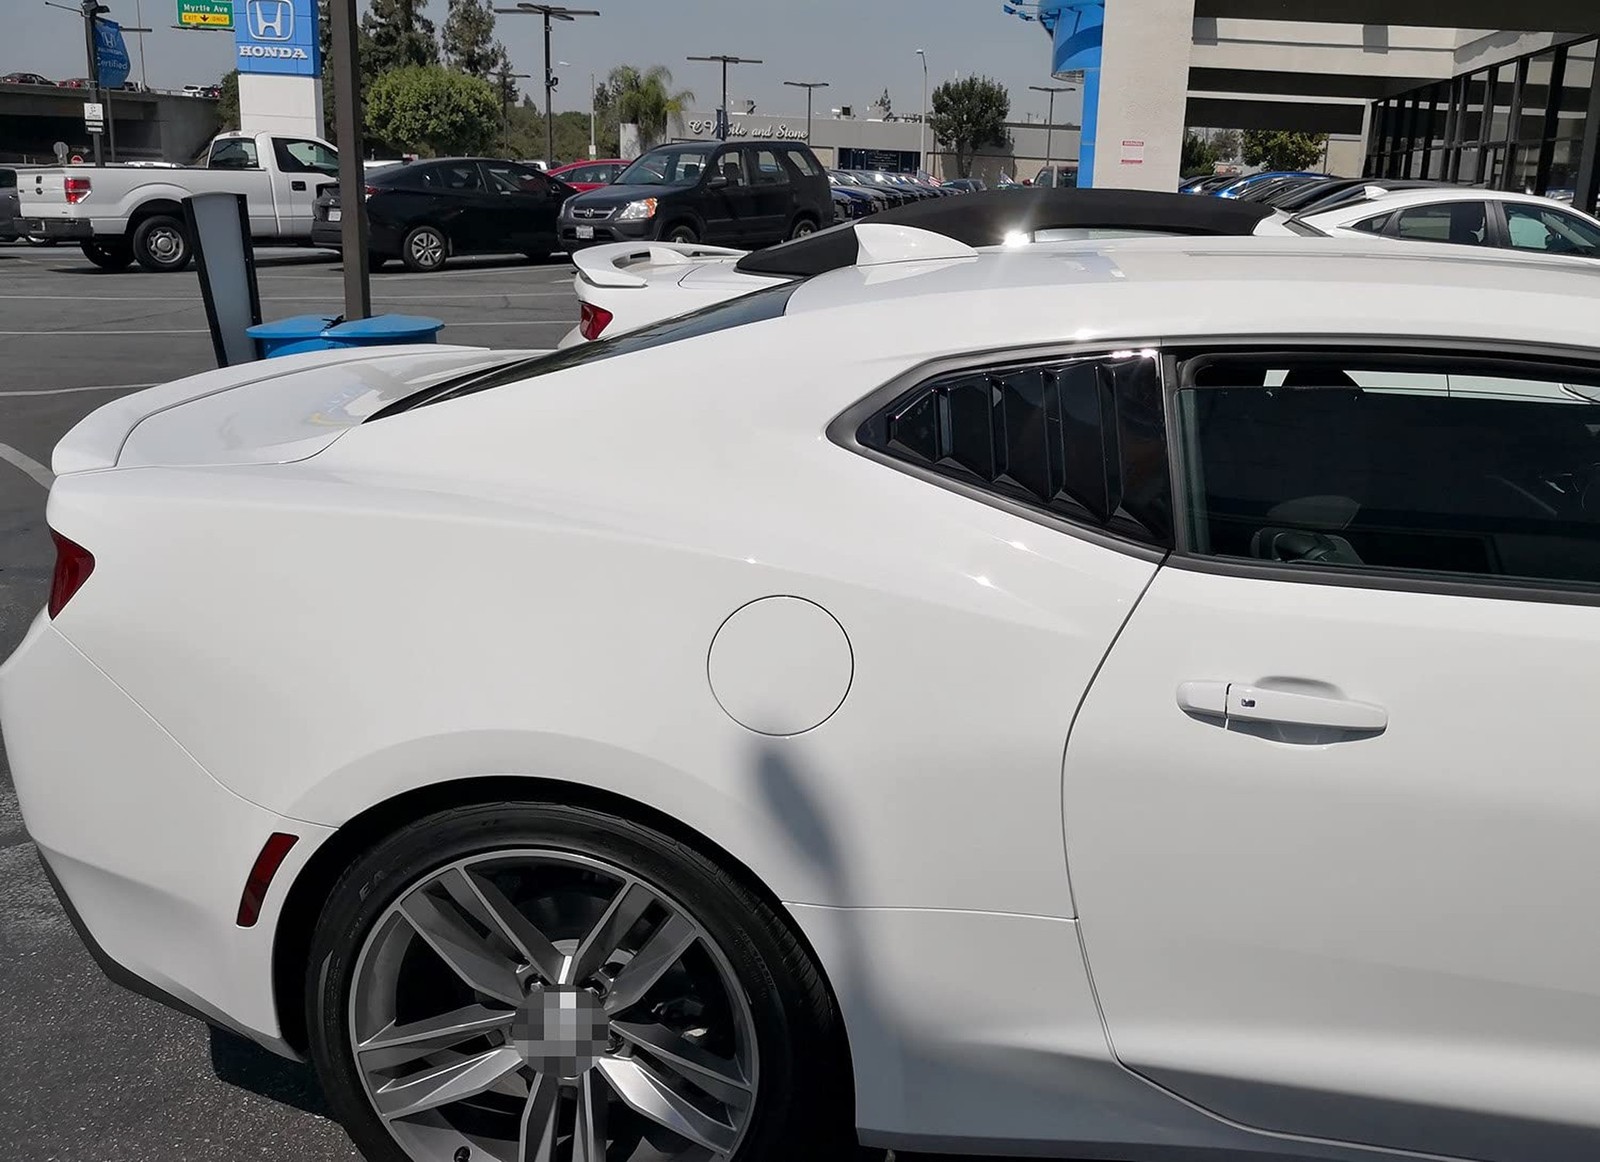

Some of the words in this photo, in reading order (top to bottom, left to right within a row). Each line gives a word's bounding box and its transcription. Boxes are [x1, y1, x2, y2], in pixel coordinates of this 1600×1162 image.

[183, 4, 210, 13] Myrtle
[213, 5, 228, 13] Ave
[183, 13, 197, 21] EXIT
[239, 45, 308, 59] HONDA
[751, 124, 773, 137] and
[776, 124, 809, 139] Stone
